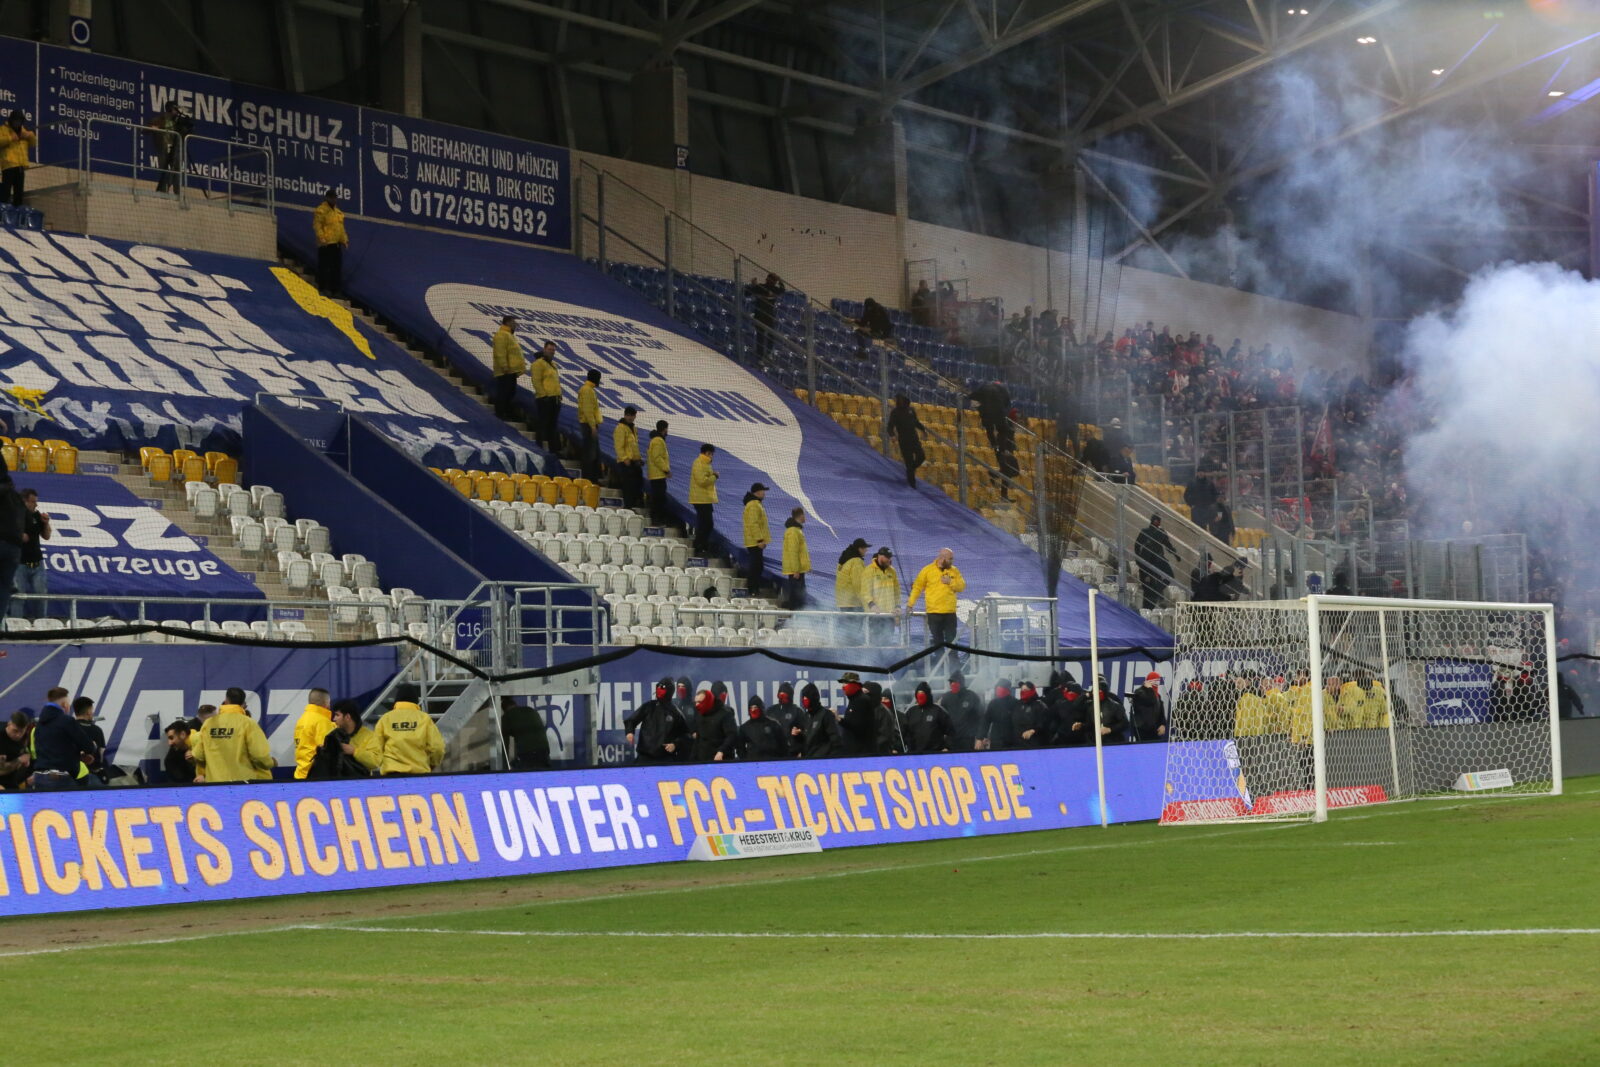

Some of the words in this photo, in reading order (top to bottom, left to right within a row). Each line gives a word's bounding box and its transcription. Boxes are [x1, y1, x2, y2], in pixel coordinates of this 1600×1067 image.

[58, 85, 135, 110] Außenanlagen
[59, 66, 135, 95] Trockenlegung
[149, 84, 233, 126] WENK
[247, 132, 344, 167] PARTNER
[411, 132, 490, 167] BRIEFMARKEN
[491, 148, 515, 172] UND
[517, 152, 560, 181] MÜNZEN
[417, 162, 461, 189] ANKAUF
[463, 170, 491, 194] JENA
[496, 176, 522, 200] DIRK
[524, 182, 555, 206] GRIES
[586, 342, 669, 381] OF
[608, 378, 788, 427] TOWN!
[457, 622, 481, 638] C16
[240, 791, 480, 880] SICHERN
[481, 783, 658, 862] UNTER:
[657, 764, 1033, 846] FCC-TICKETSHOP.DE
